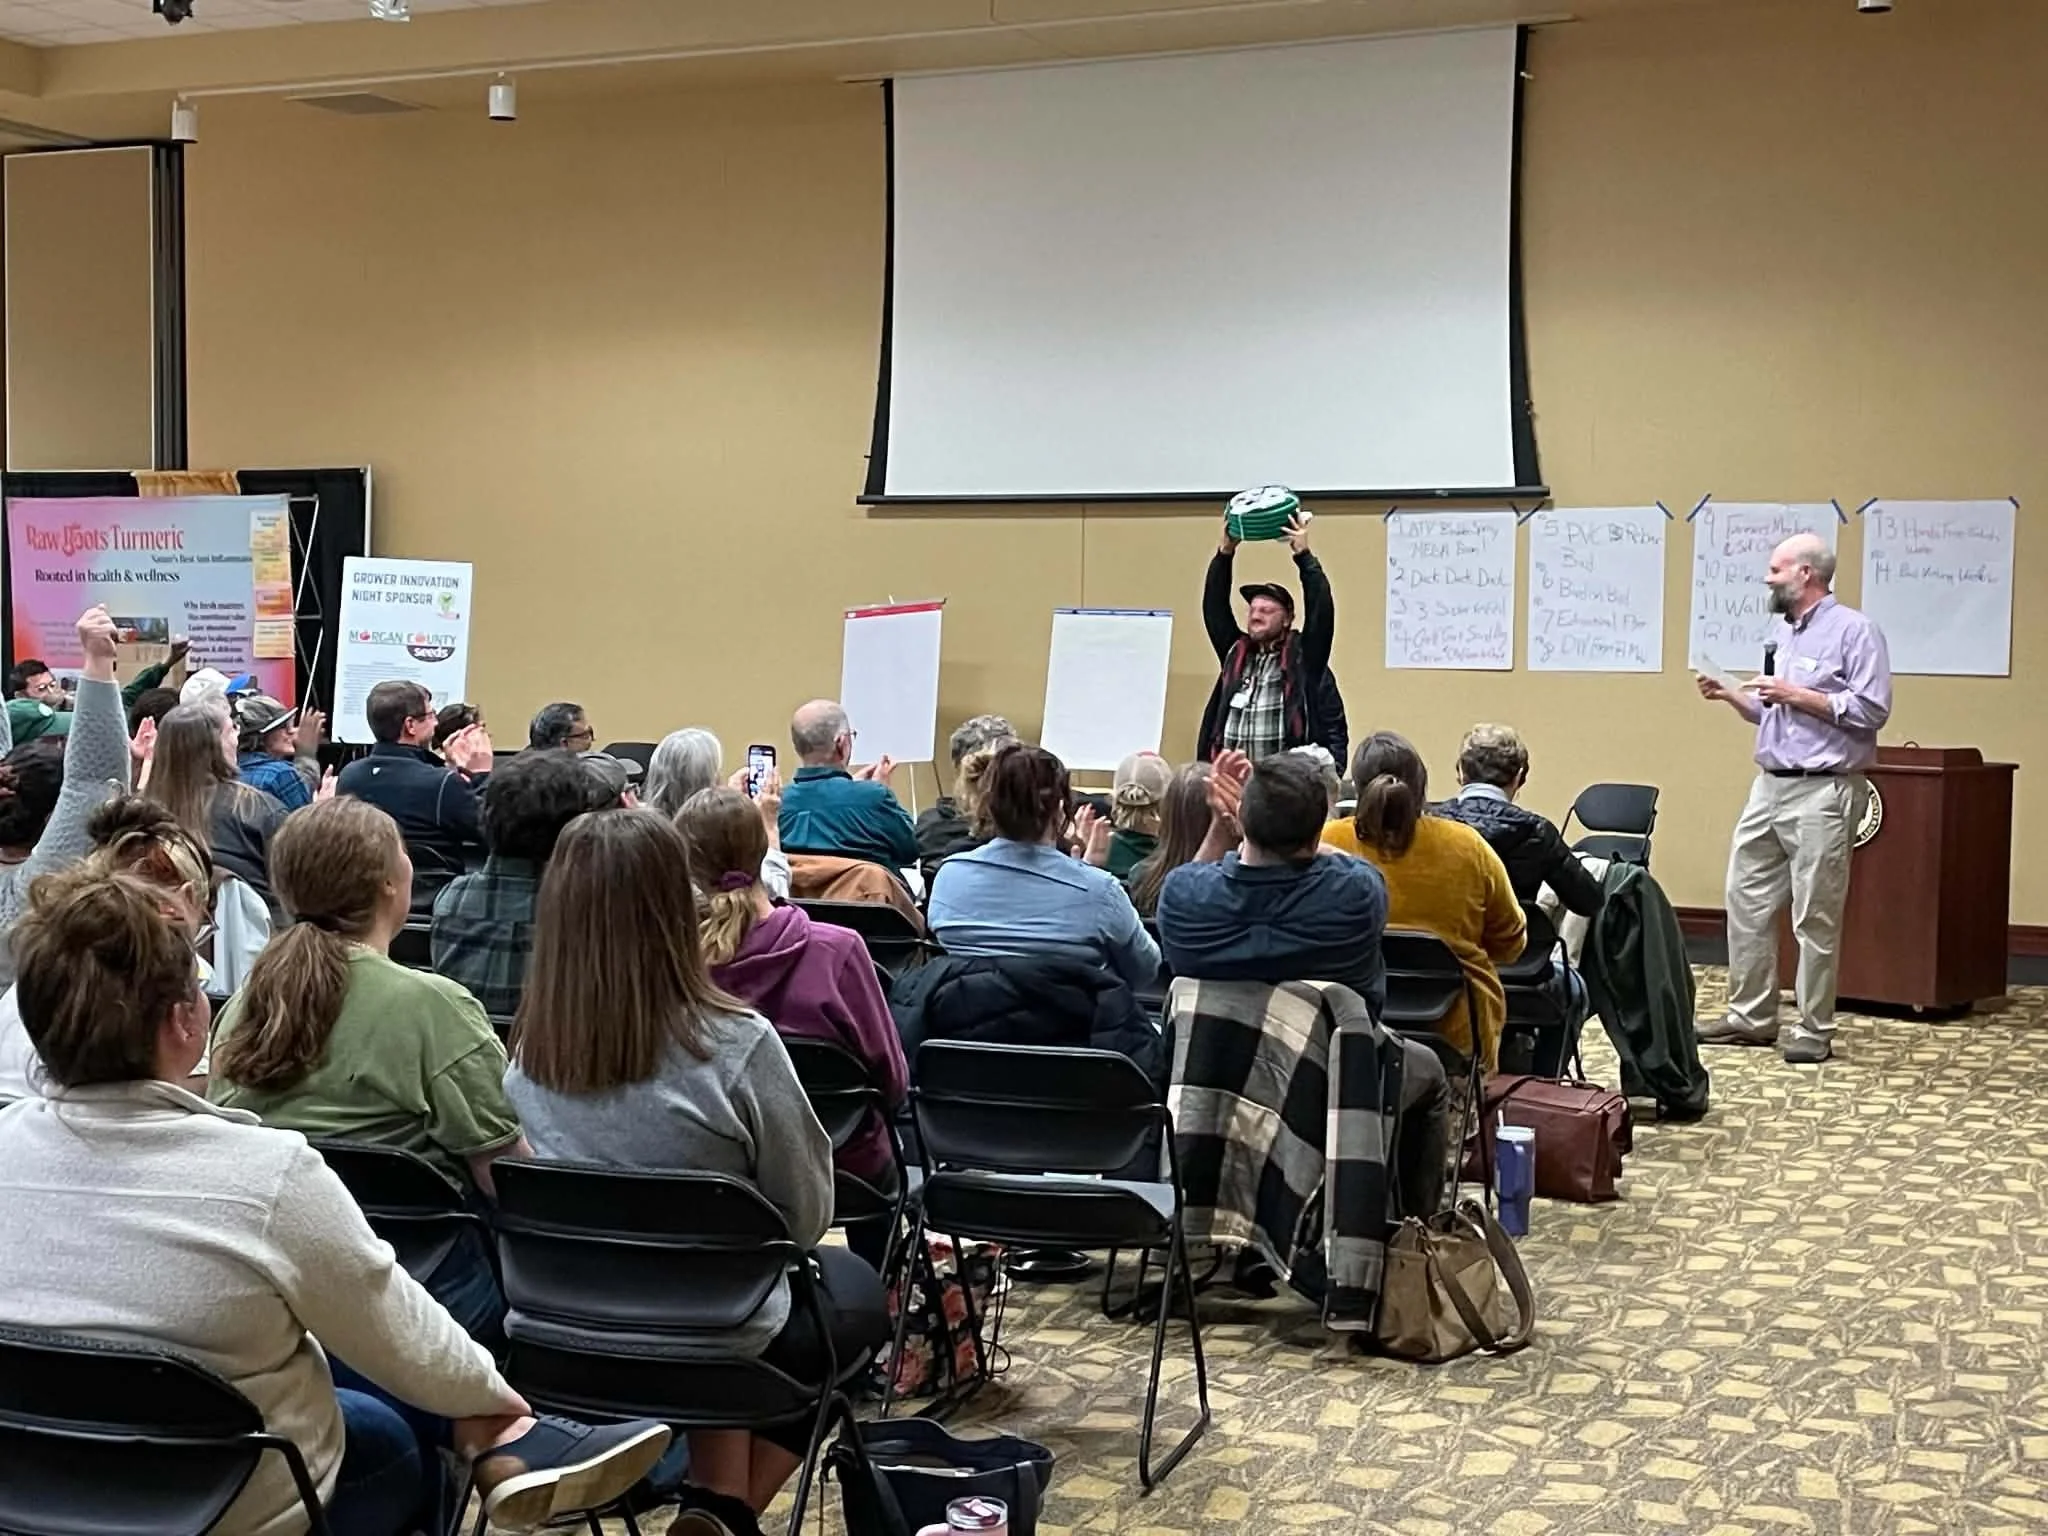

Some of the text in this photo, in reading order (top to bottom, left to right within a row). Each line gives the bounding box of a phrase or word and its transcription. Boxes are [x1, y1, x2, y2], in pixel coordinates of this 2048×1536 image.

[26, 525, 64, 550] Raw
[111, 524, 184, 551] Turmeric
[35, 569, 180, 582] Rooted in health & wellness
[353, 572, 459, 589] GROWER INNOVATION
[352, 590, 433, 605] NIGHT SPONSOR
[350, 630, 457, 646] MORGAN COUNTY
